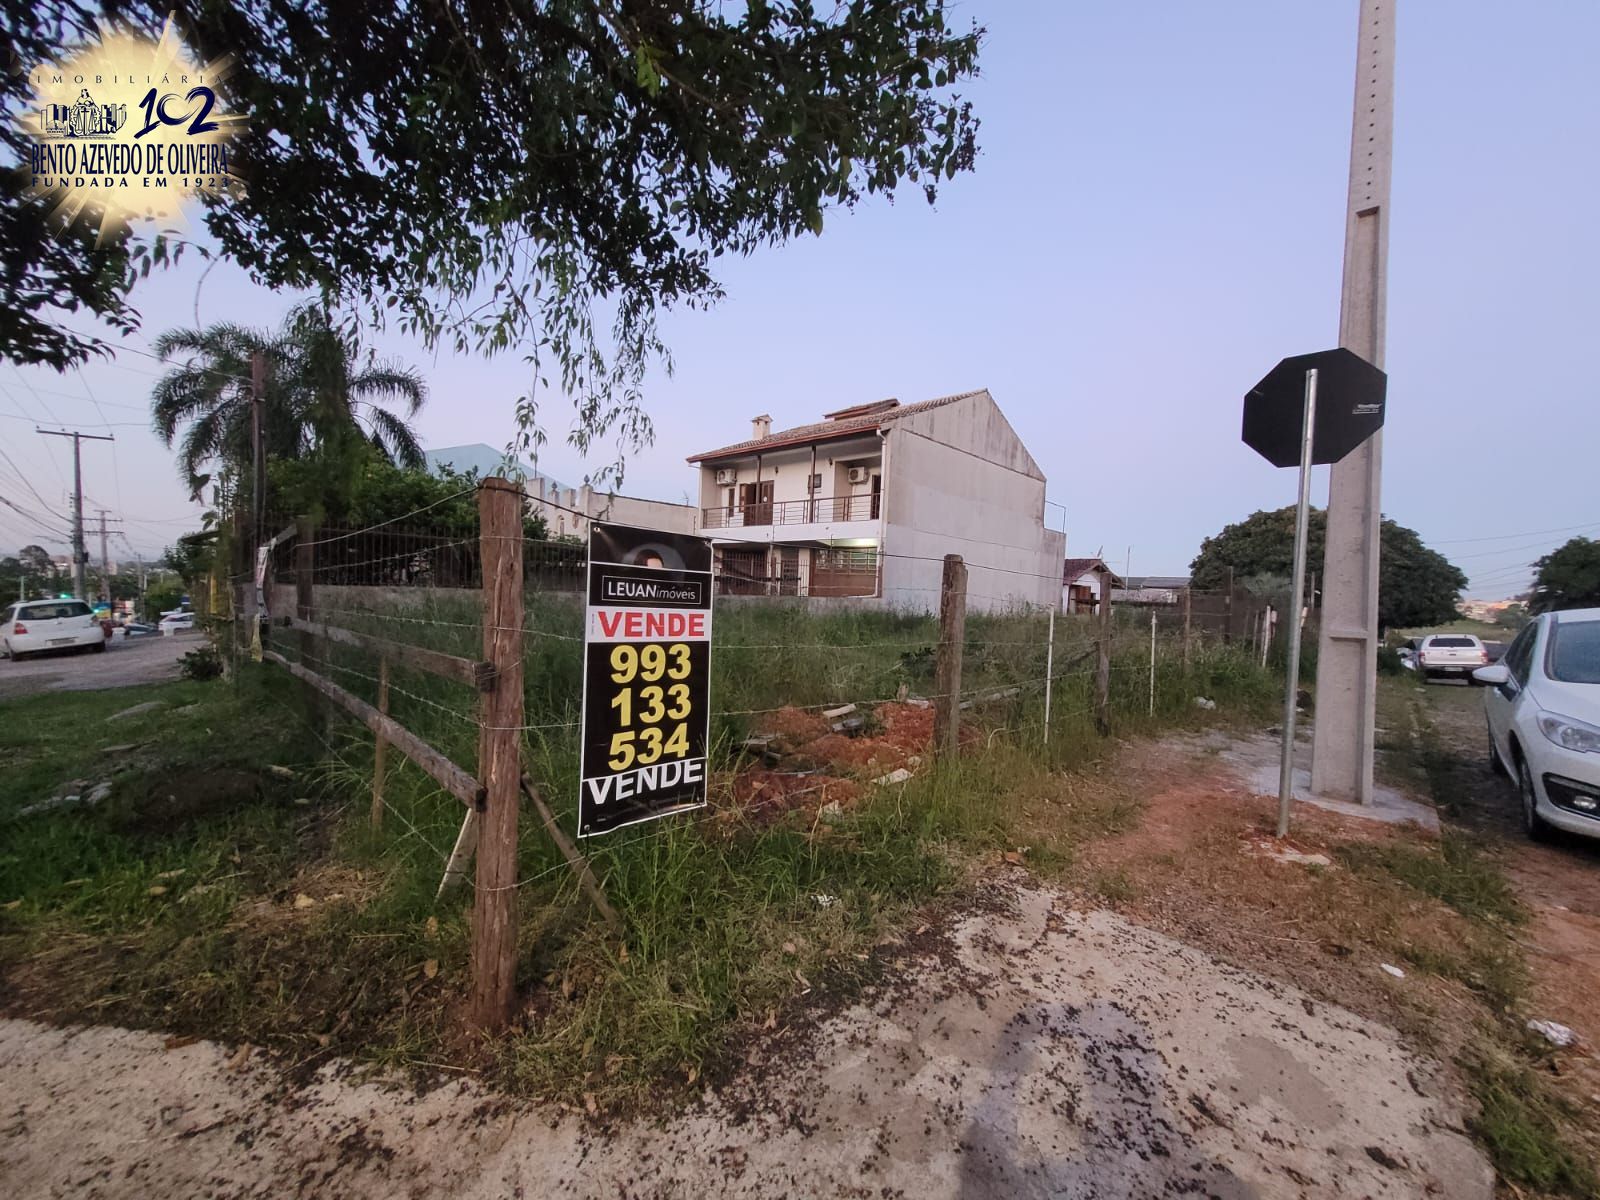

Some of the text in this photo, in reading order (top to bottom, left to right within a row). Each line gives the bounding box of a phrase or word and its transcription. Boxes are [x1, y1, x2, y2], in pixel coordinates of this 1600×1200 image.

[598, 611, 705, 638] VENDE
[610, 643, 692, 684] 993
[611, 683, 692, 727] 133
[607, 722, 690, 771] 534
[587, 758, 703, 805] VENDE
